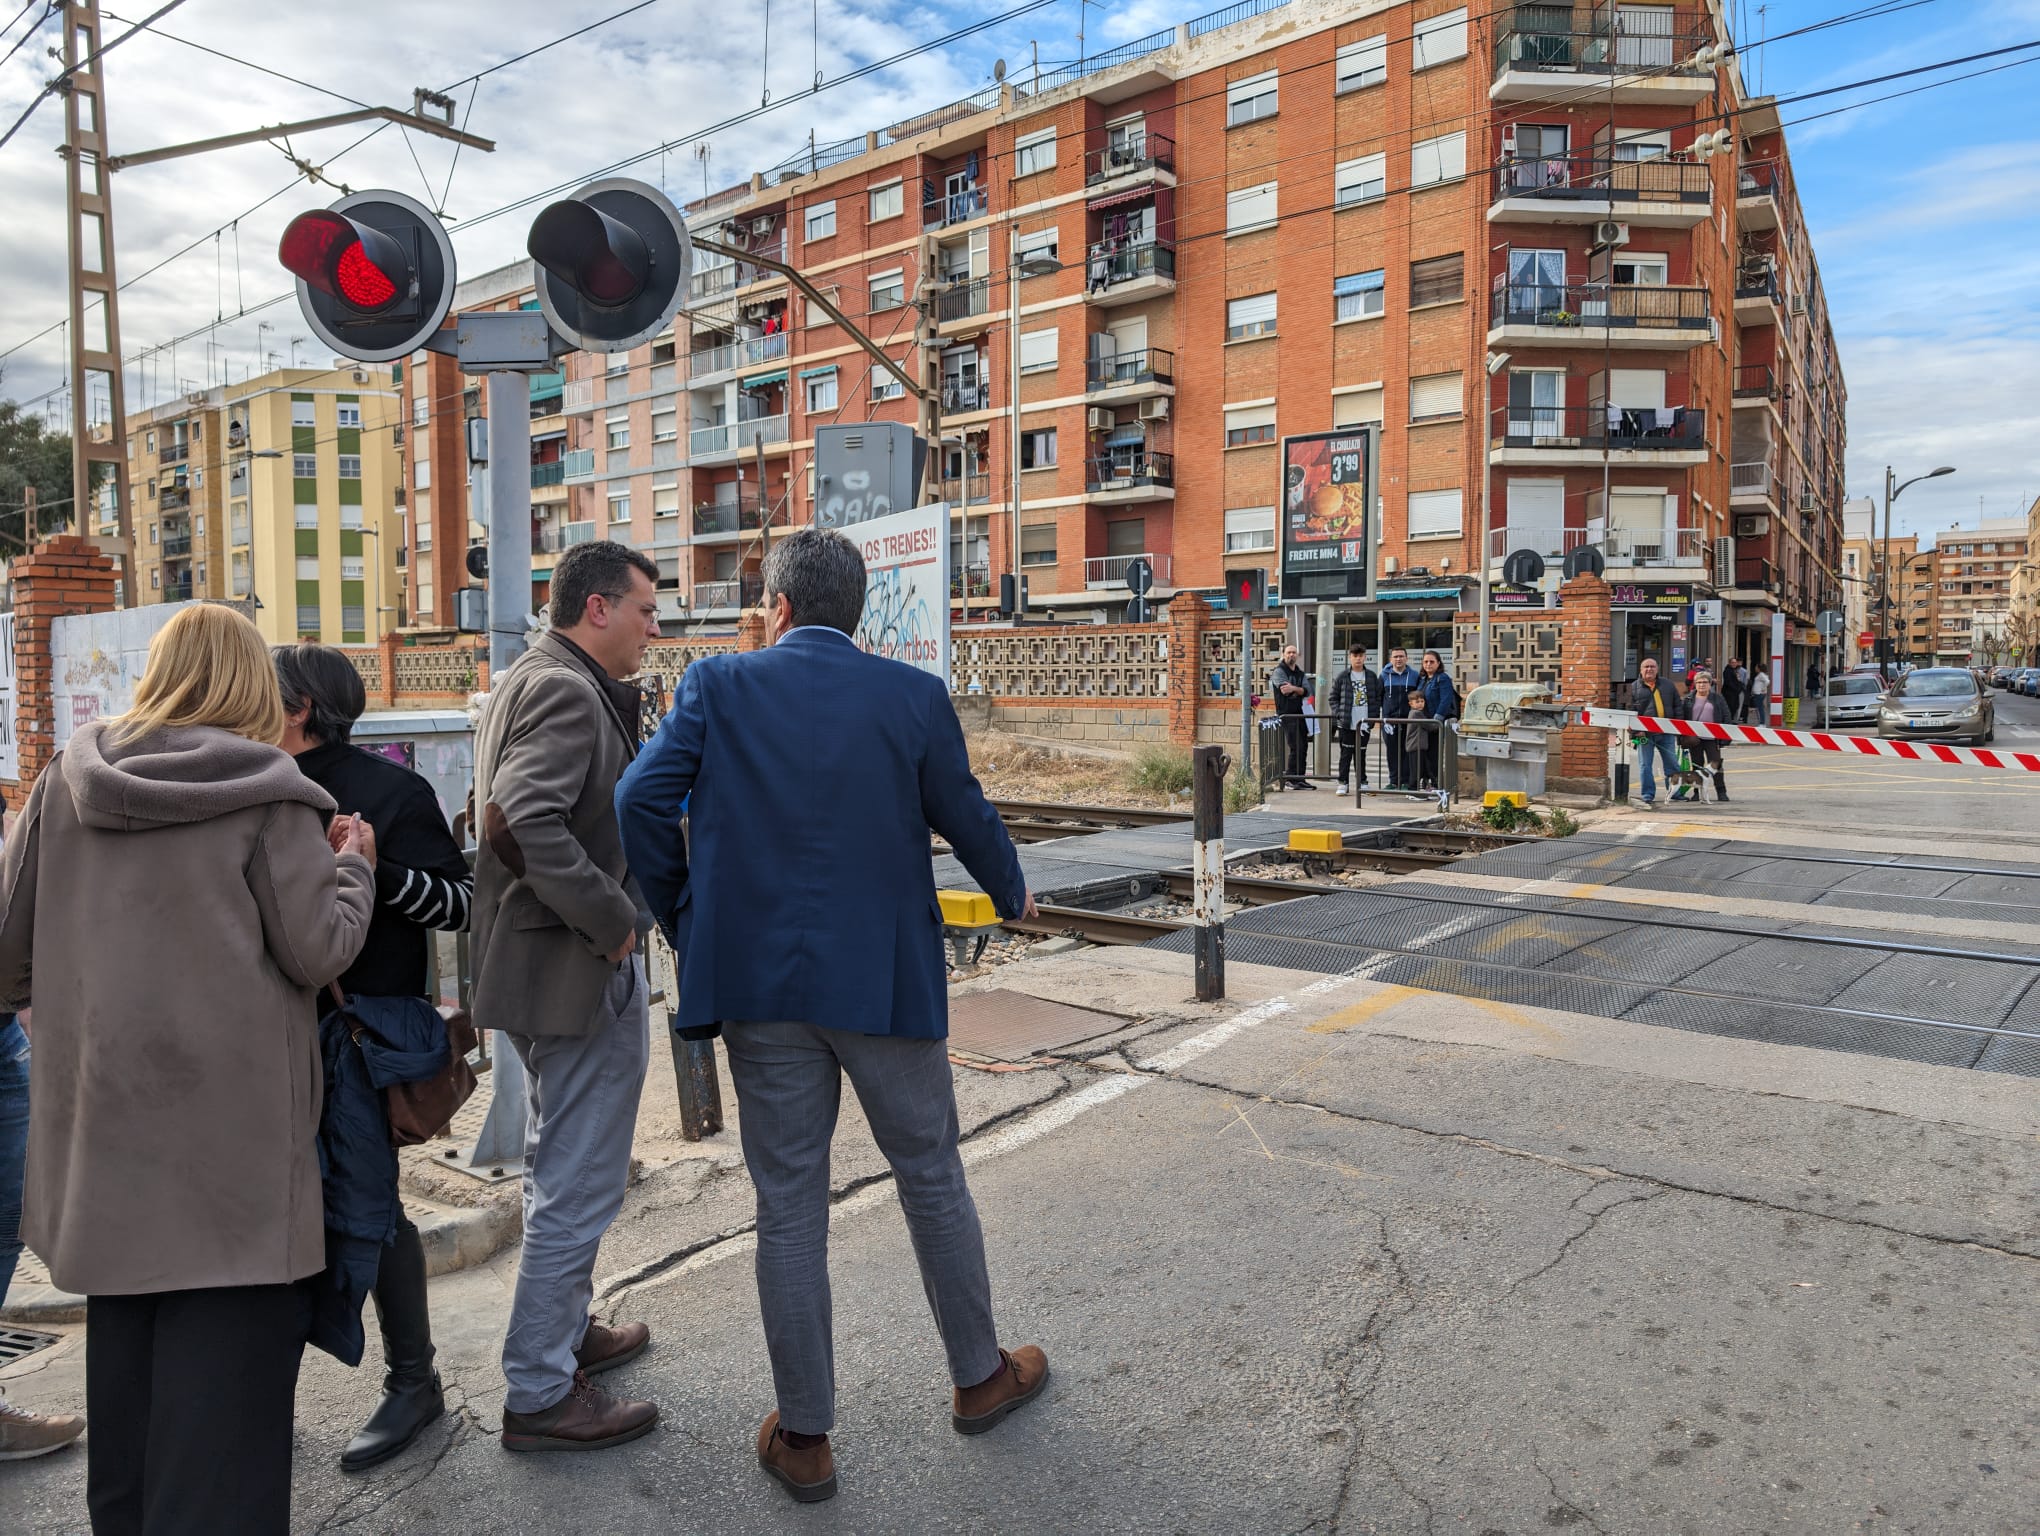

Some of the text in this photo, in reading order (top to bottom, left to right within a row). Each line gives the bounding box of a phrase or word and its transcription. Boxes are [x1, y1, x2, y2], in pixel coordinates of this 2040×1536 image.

[883, 527, 936, 558] TRENES!!
[1288, 547, 1338, 561] FRENTE MN4
[897, 634, 937, 661] ambos
